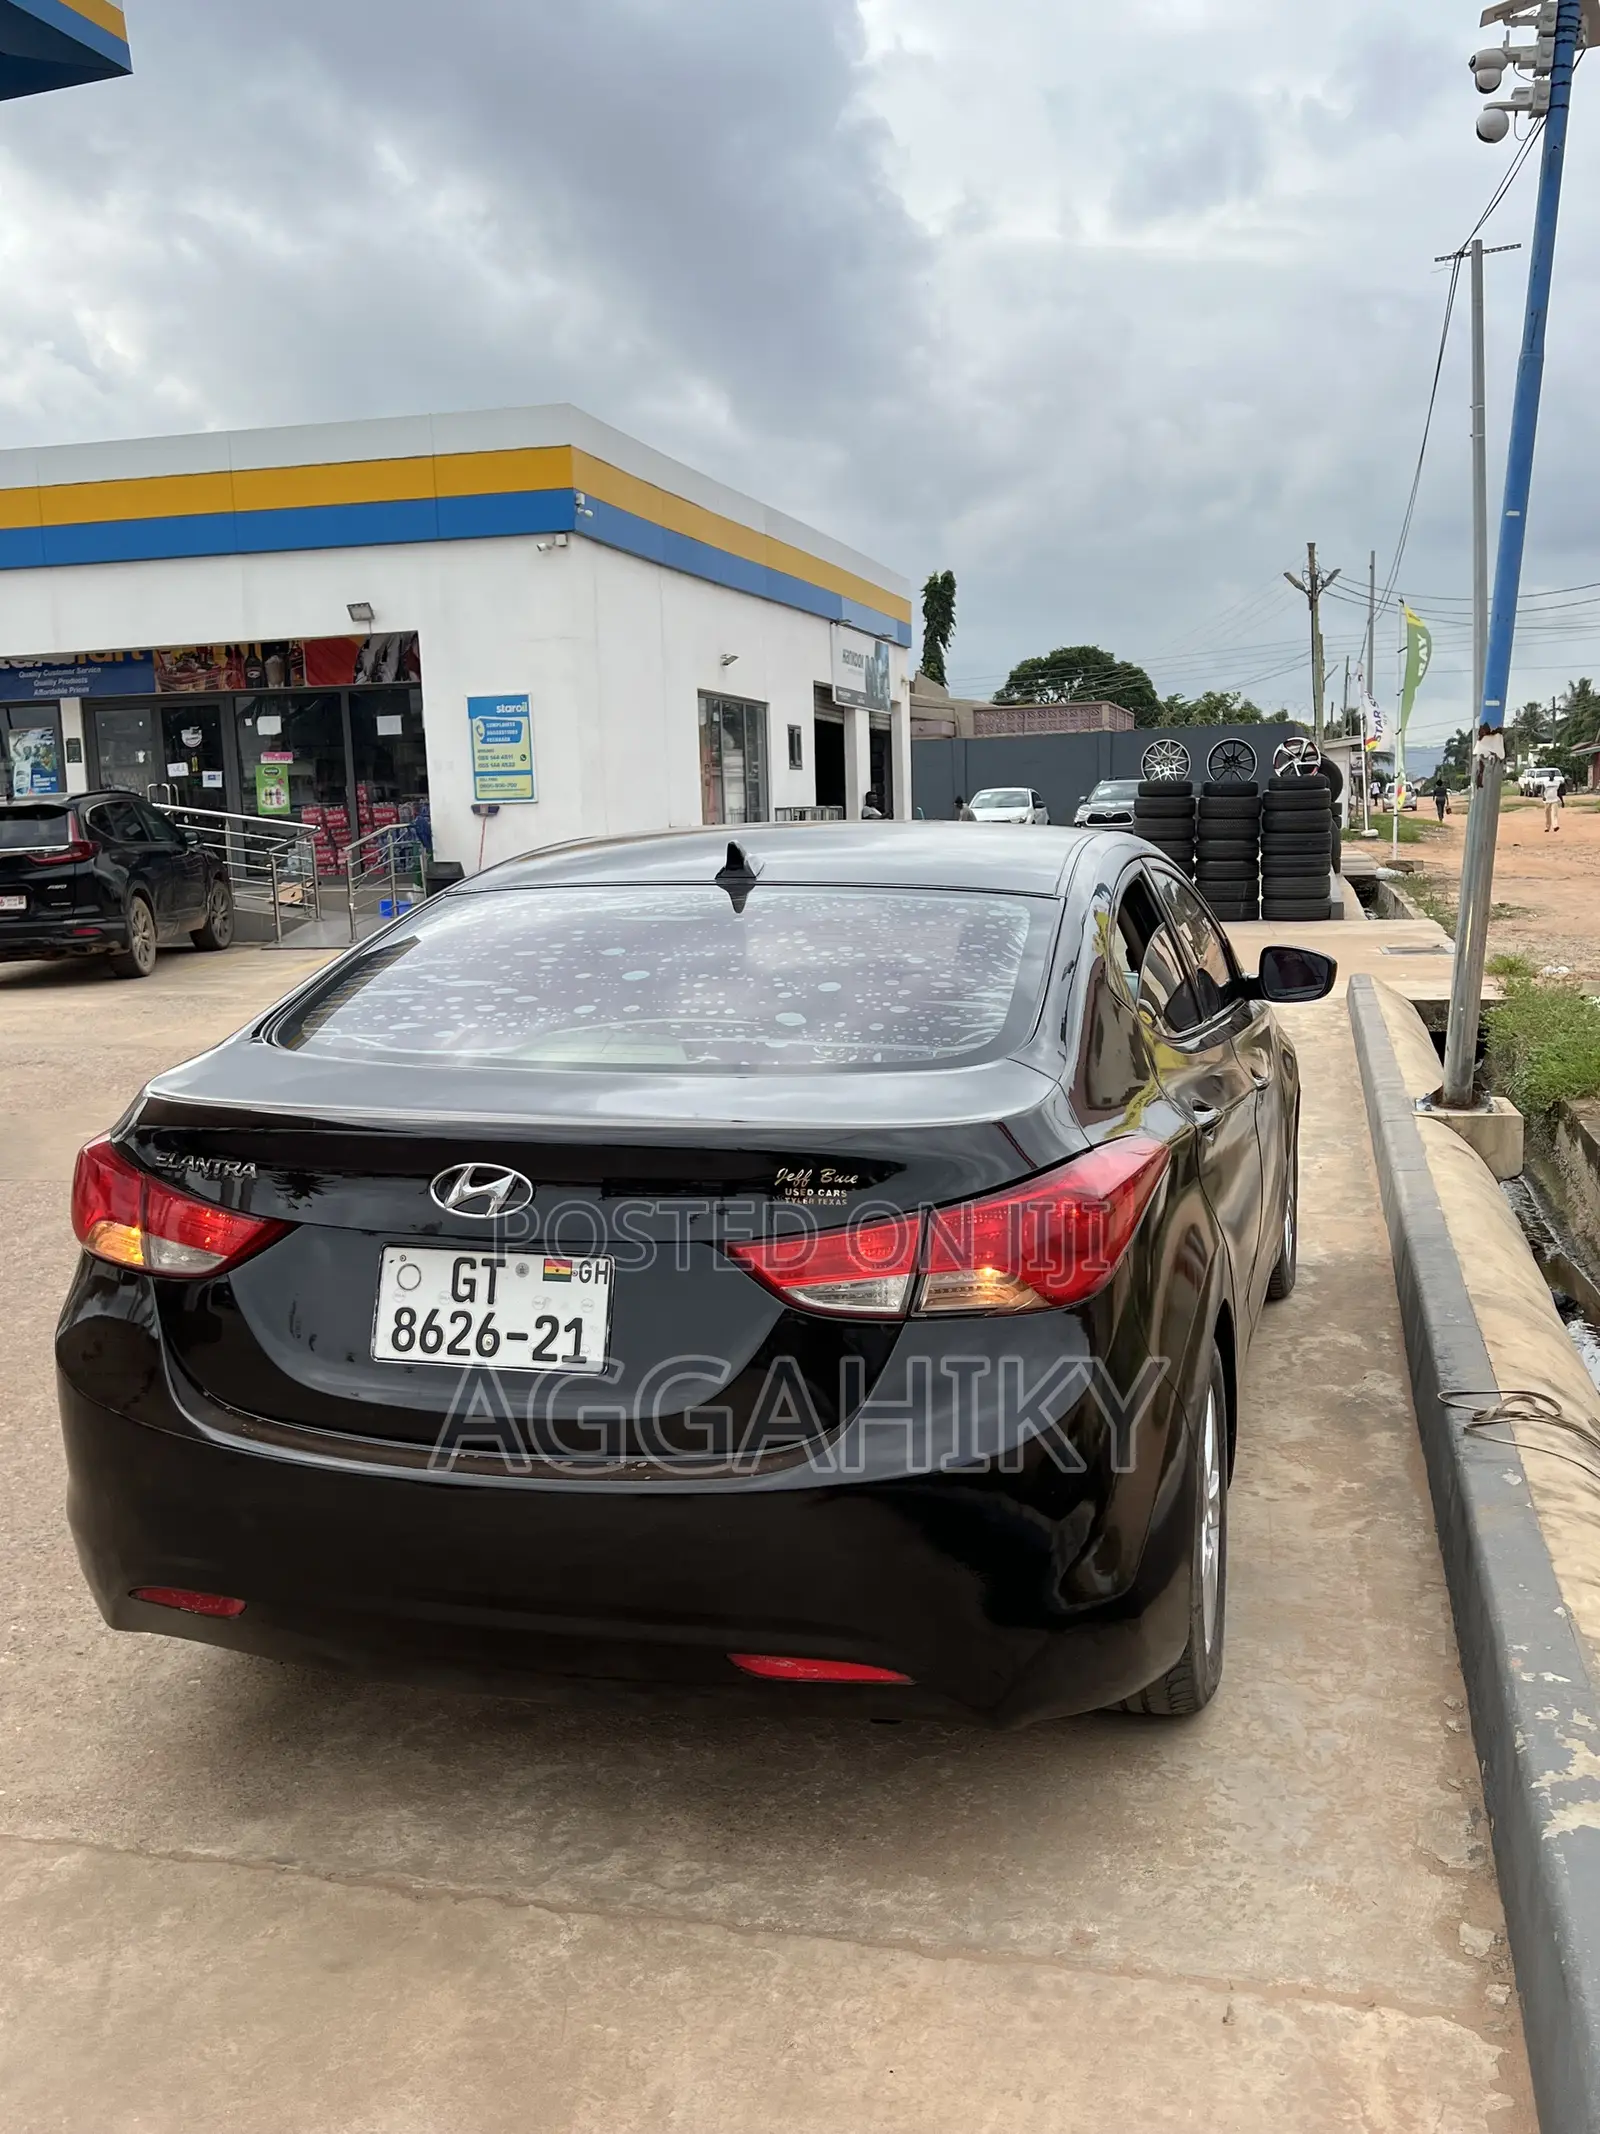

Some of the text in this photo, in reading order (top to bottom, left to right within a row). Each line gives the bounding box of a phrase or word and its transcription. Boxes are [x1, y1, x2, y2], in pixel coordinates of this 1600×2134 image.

[19, 667, 101, 679] Quality Customer Service
[34, 677, 88, 687] Quality Products
[34, 686, 89, 696] Affordable Prices
[496, 702, 528, 713] staroil
[156, 1152, 257, 1178] ELANTRA
[774, 1167, 813, 1187] Jeff
[785, 1187, 848, 1198] USED CARS
[785, 1197, 848, 1206] TYLER TEXAS
[451, 1256, 610, 1305] GT GH
[391, 1306, 588, 1364] 8626-21
